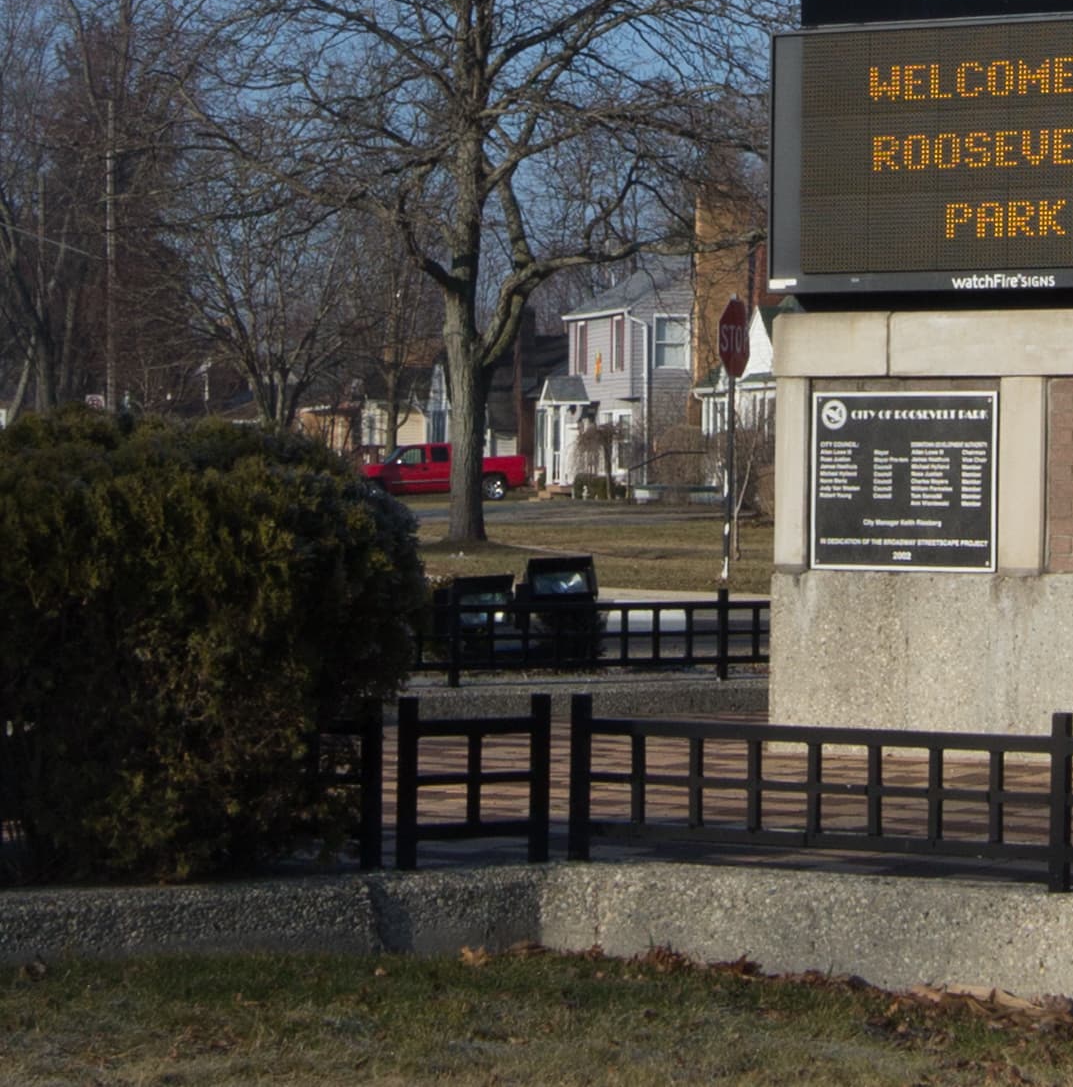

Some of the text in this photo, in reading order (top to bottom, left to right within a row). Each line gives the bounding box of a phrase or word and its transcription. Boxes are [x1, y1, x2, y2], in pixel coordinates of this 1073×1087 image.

[946, 200, 1065, 238] PARK
[720, 324, 749, 353] STOP
[851, 410, 988, 419] CITY OF ROOSEVELT PARK
